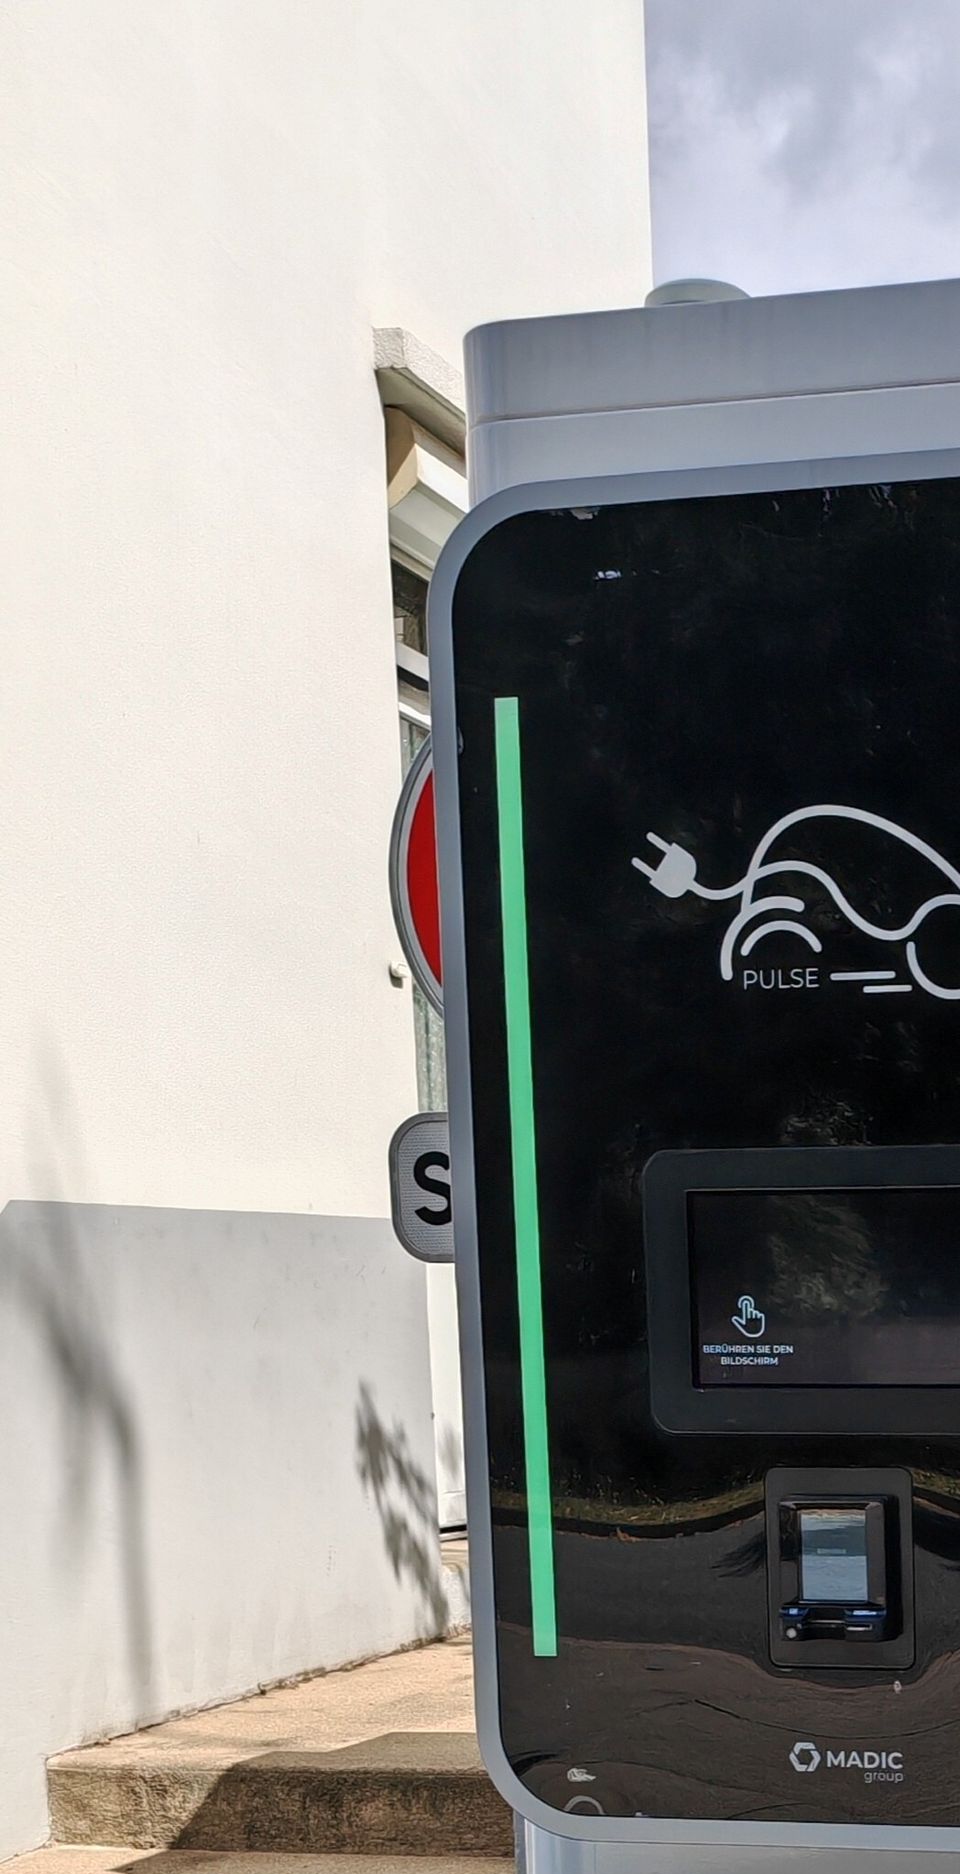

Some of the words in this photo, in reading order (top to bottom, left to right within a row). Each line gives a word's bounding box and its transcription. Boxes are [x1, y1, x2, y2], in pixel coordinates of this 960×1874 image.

[742, 968, 820, 990] PULSE
[756, 1345, 771, 1354] SIE
[773, 1345, 794, 1354] DEN
[720, 1356, 779, 1366] BILDSCHIRM
[826, 1750, 903, 1770] MADIC
[863, 1771, 904, 1784] group
